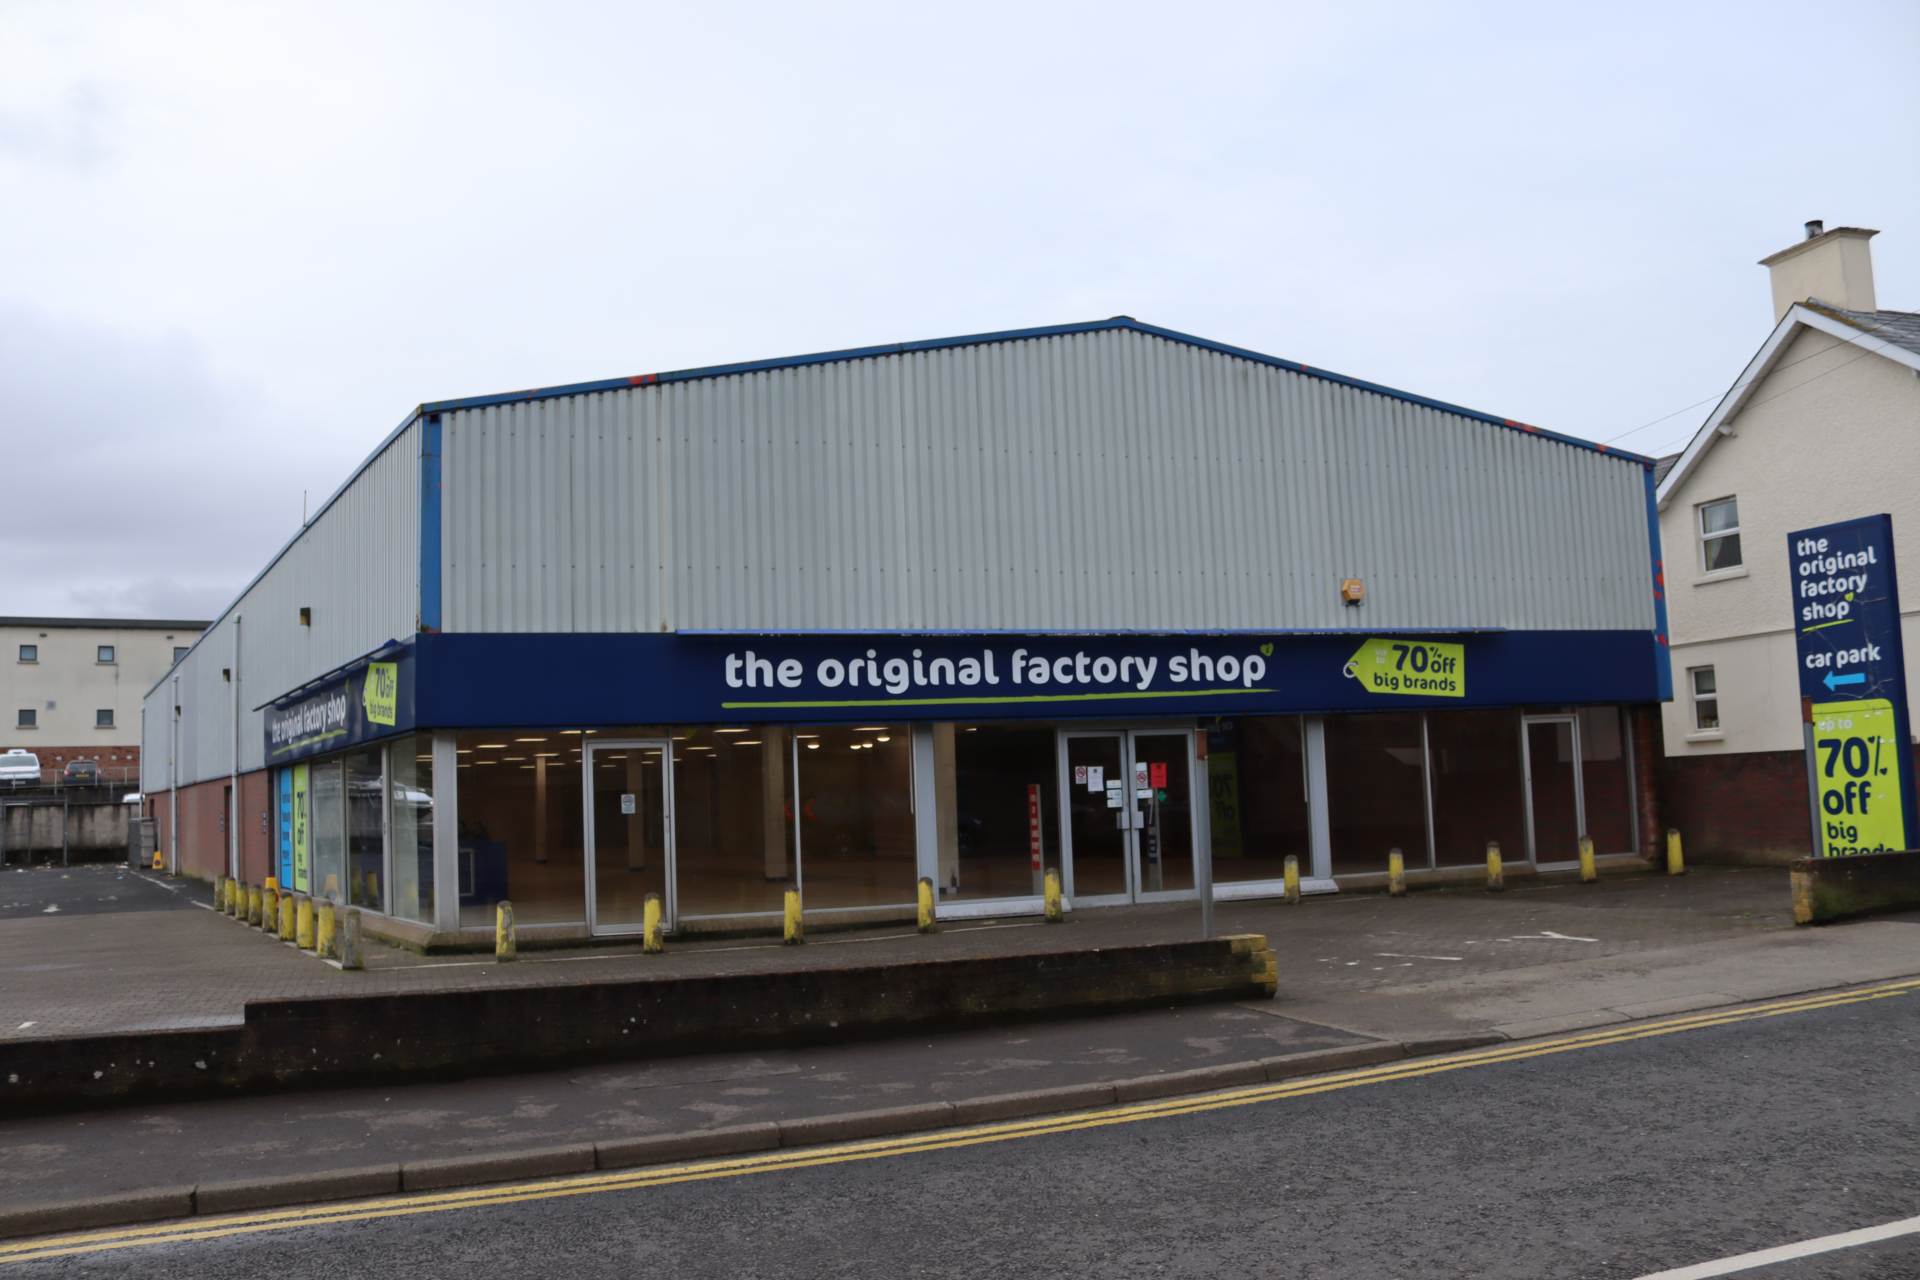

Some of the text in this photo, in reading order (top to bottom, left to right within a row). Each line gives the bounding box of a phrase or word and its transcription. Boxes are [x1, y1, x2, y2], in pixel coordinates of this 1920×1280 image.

[1797, 537, 1829, 556] the
[1799, 546, 1877, 575] original
[1800, 573, 1868, 598] factory
[1802, 601, 1850, 621] shop
[1392, 644, 1442, 673] 70%
[1430, 657, 1457, 674] off
[1806, 642, 1882, 669] car park
[725, 648, 1267, 694] the original factory shop
[1373, 672, 1457, 692] big brands
[272, 693, 346, 744] the original factory shop
[1818, 736, 1888, 778] 70%
[1823, 781, 1872, 815] off
[1826, 821, 1858, 843] big
